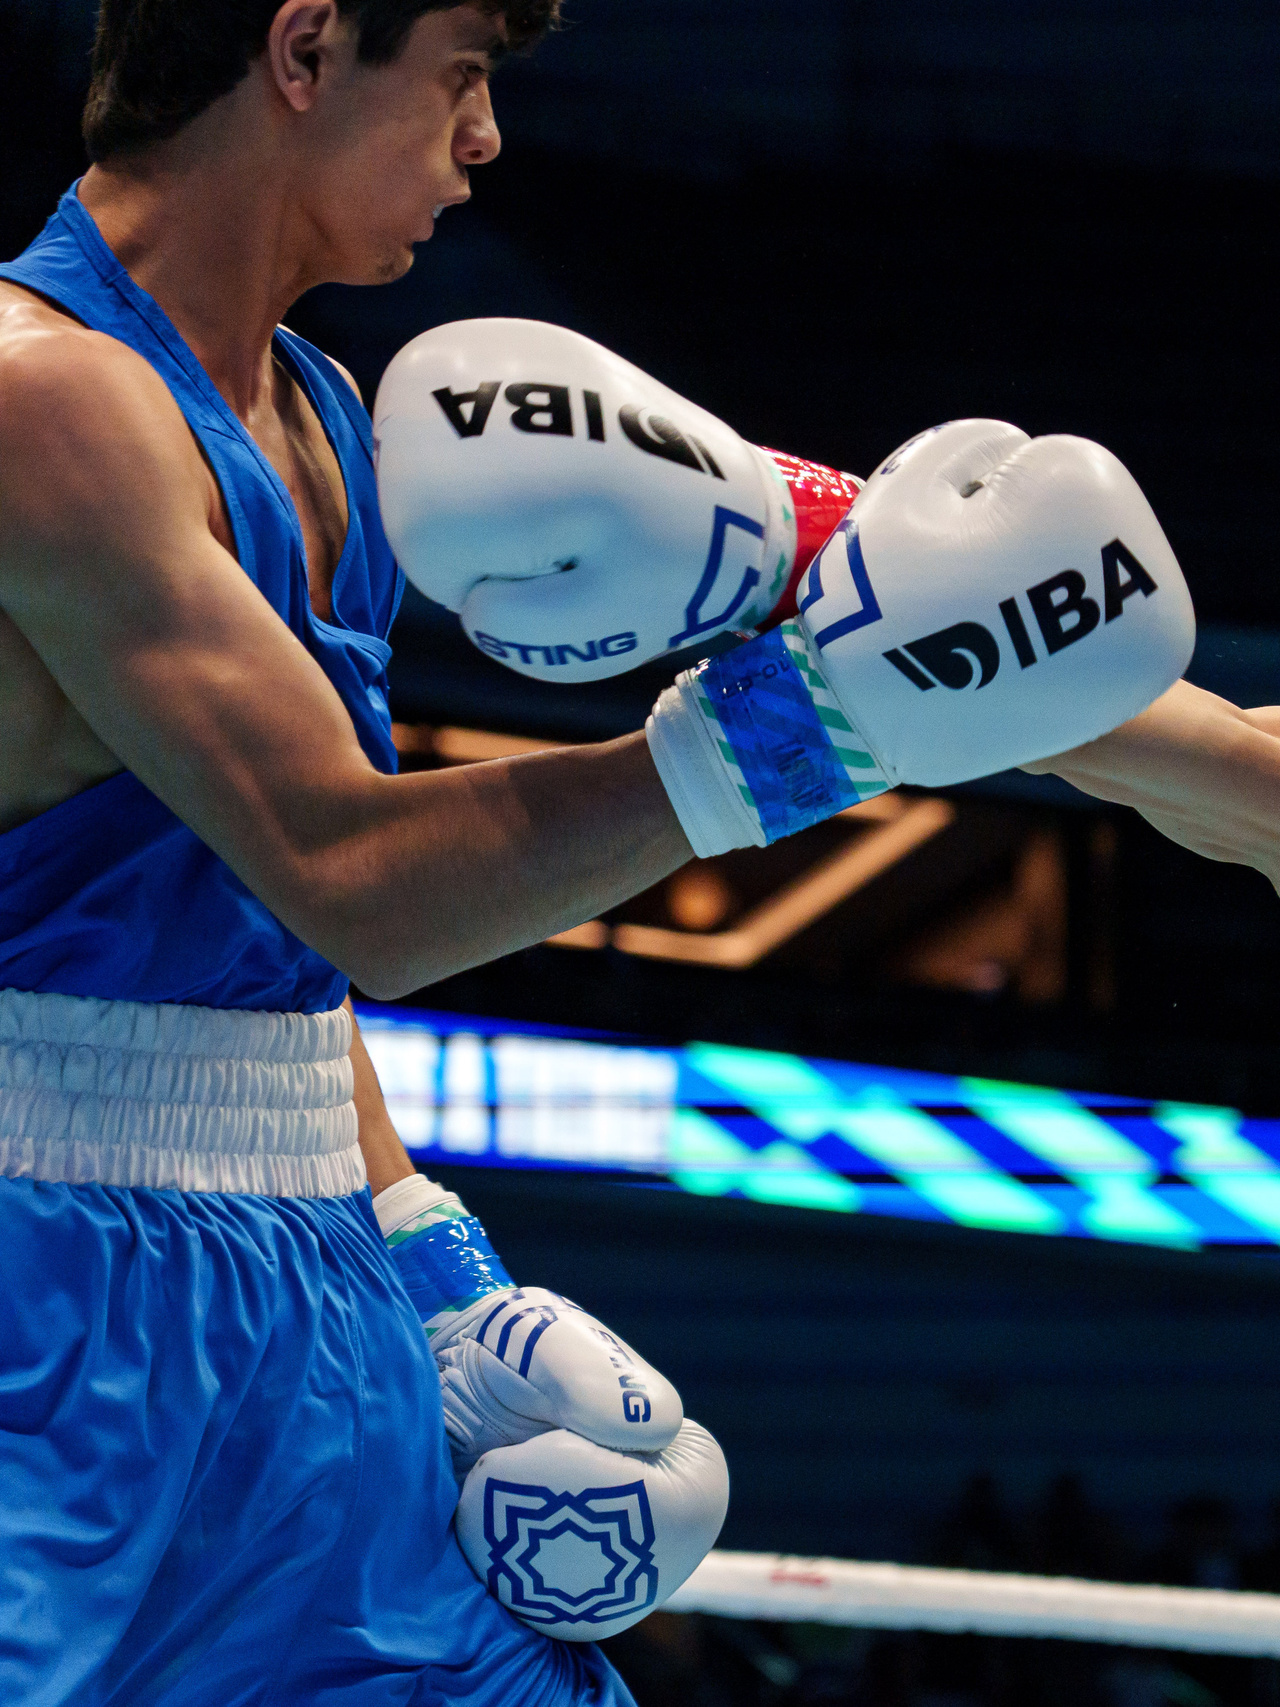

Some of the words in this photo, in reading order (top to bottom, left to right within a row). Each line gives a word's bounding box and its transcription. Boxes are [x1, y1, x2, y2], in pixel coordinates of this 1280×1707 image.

[432, 381, 606, 443] IBA
[997, 537, 1159, 670] IBA
[474, 631, 638, 666] STING
